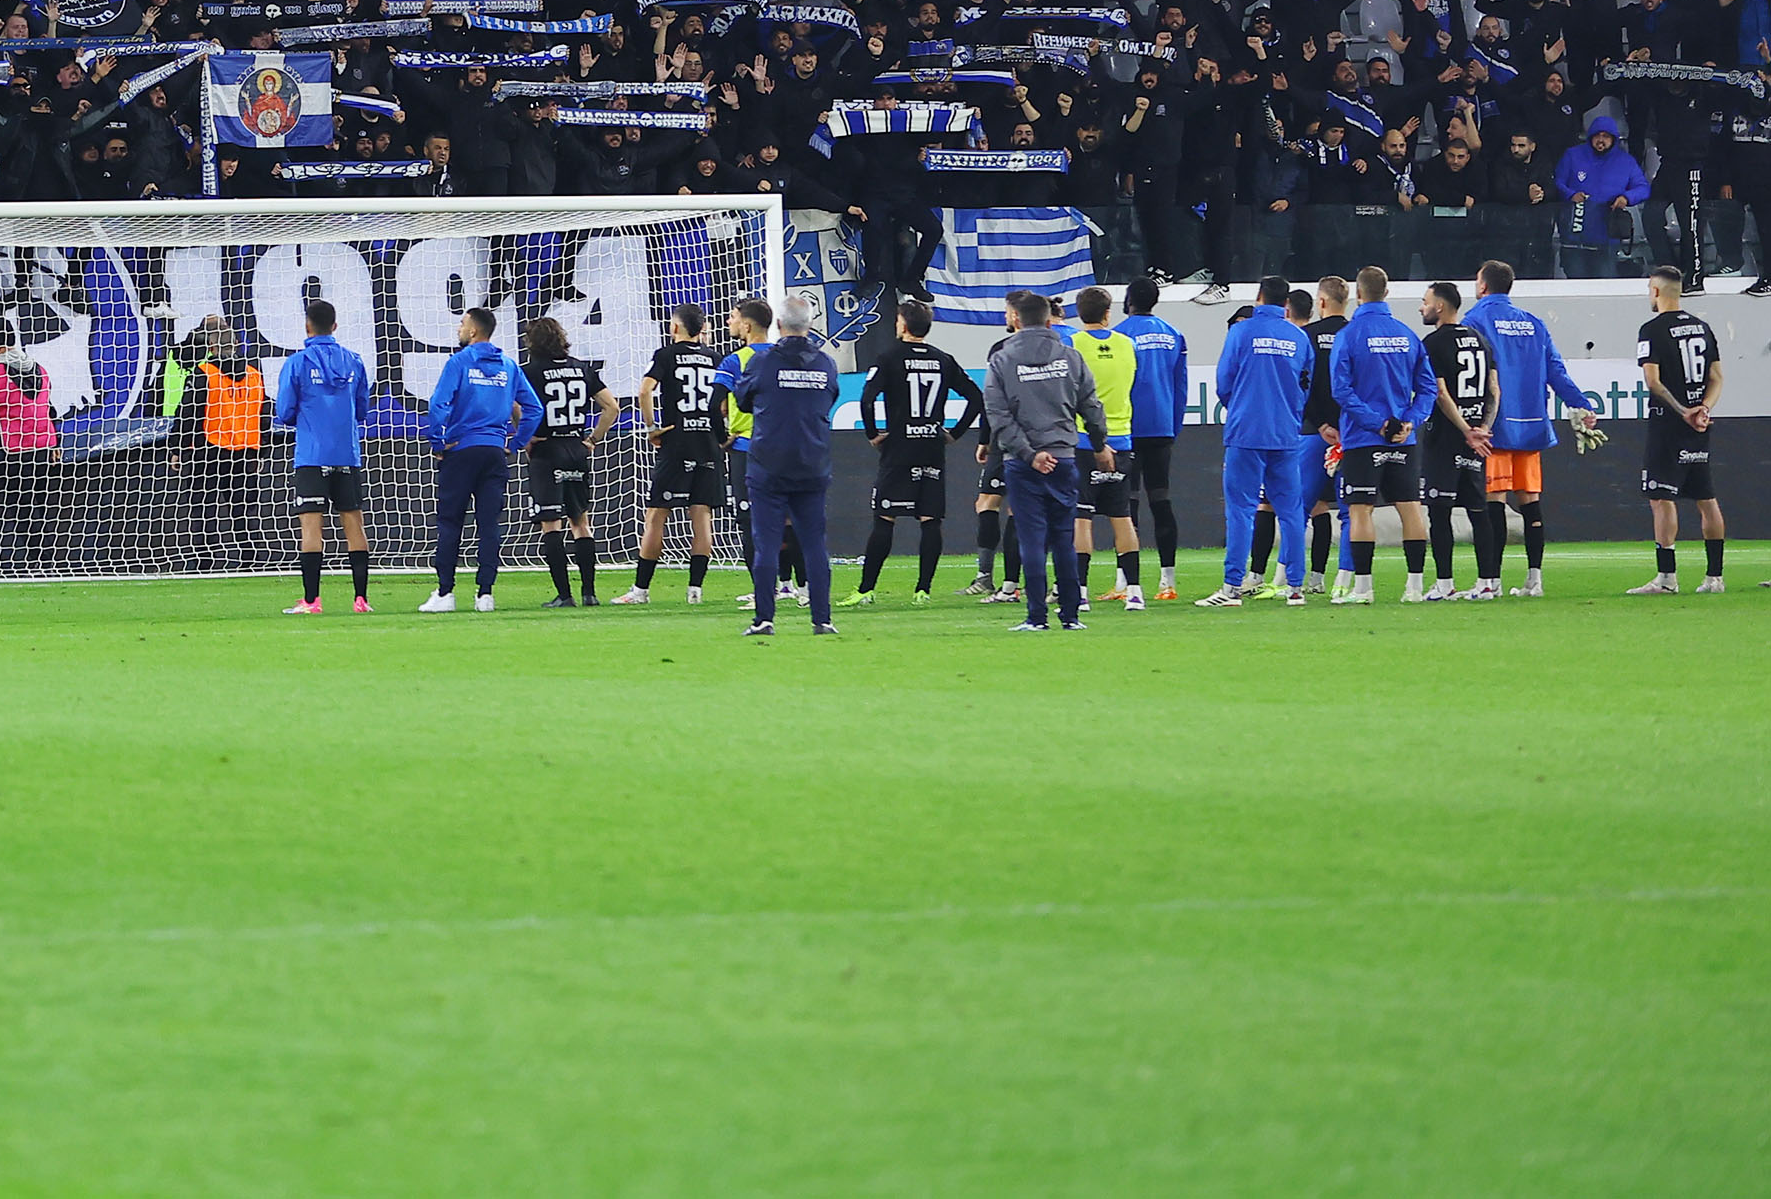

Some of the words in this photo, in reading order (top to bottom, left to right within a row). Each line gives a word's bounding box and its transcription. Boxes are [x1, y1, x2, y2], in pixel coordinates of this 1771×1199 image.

[557, 110, 640, 126] FAMAGUSTA
[654, 113, 707, 130] GHETTO
[1494, 319, 1535, 331] ANORTHOSIS
[1134, 331, 1176, 345] ANORTHOSIS
[1251, 337, 1297, 351] ANORTHOSIS
[1367, 336, 1410, 348] ANORTHOSIS
[1678, 337, 1707, 384] 16
[777, 370, 828, 383] ANORTHOSIS
[1457, 350, 1486, 399] 21
[674, 366, 718, 413] 35
[907, 372, 942, 418] 17
[545, 380, 587, 428] 22
[905, 423, 939, 435] IronFX
